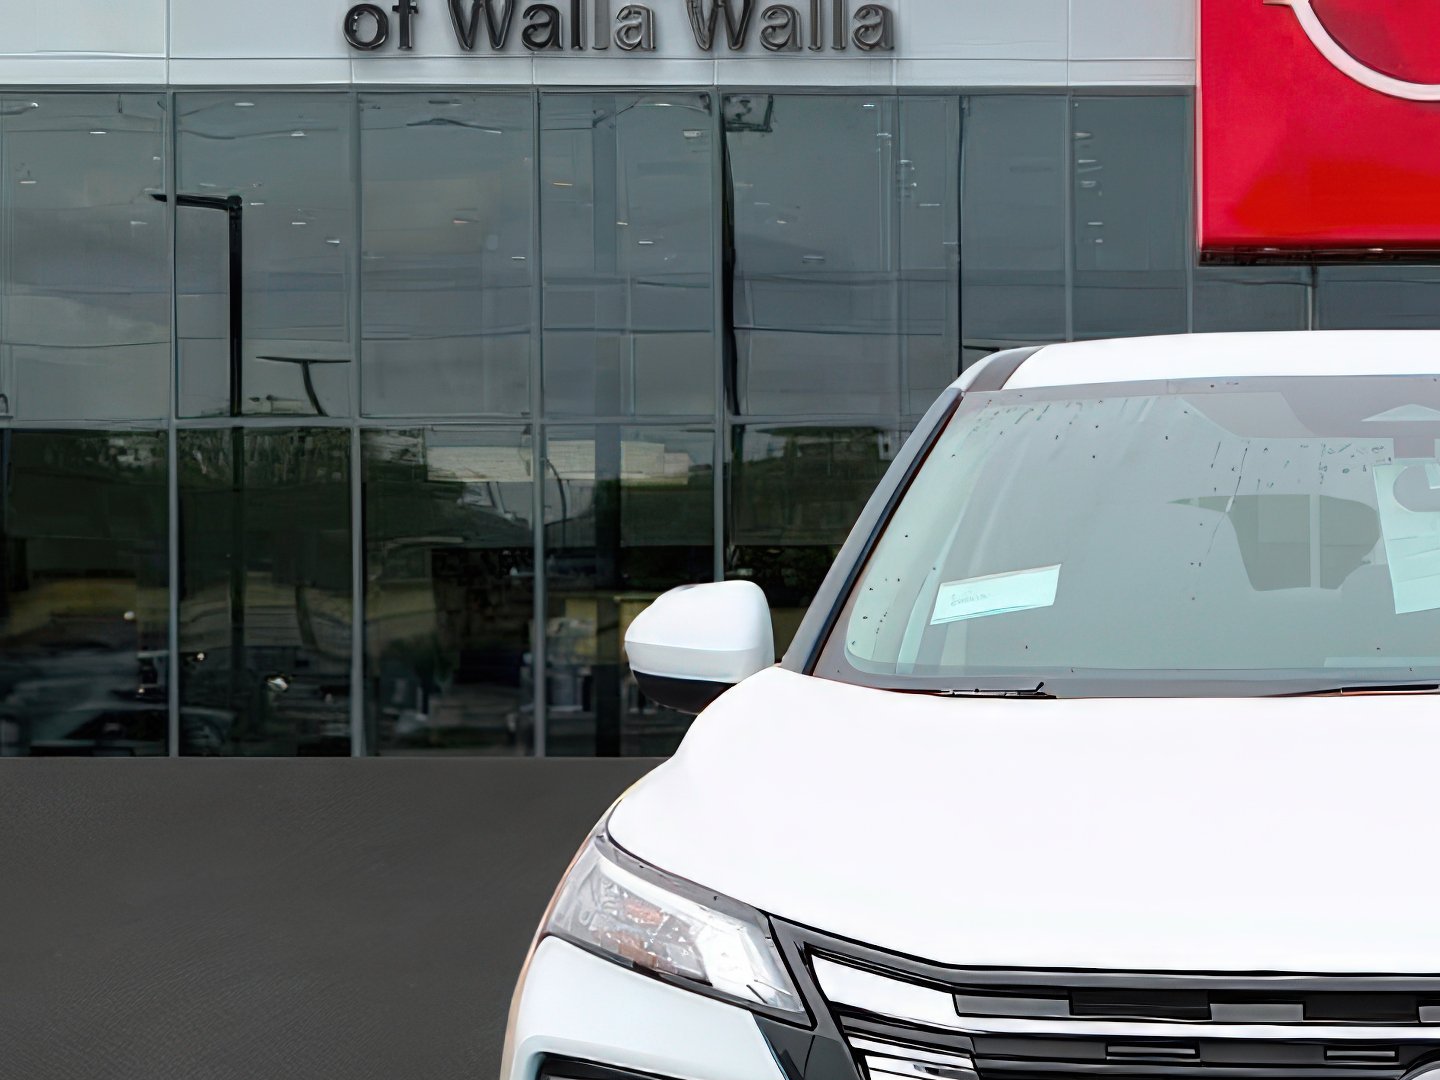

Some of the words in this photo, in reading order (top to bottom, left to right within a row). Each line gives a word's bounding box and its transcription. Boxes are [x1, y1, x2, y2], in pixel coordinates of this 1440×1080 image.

[342, 0, 419, 51] of
[447, 0, 657, 52] Walla
[684, 0, 895, 52] Walla
